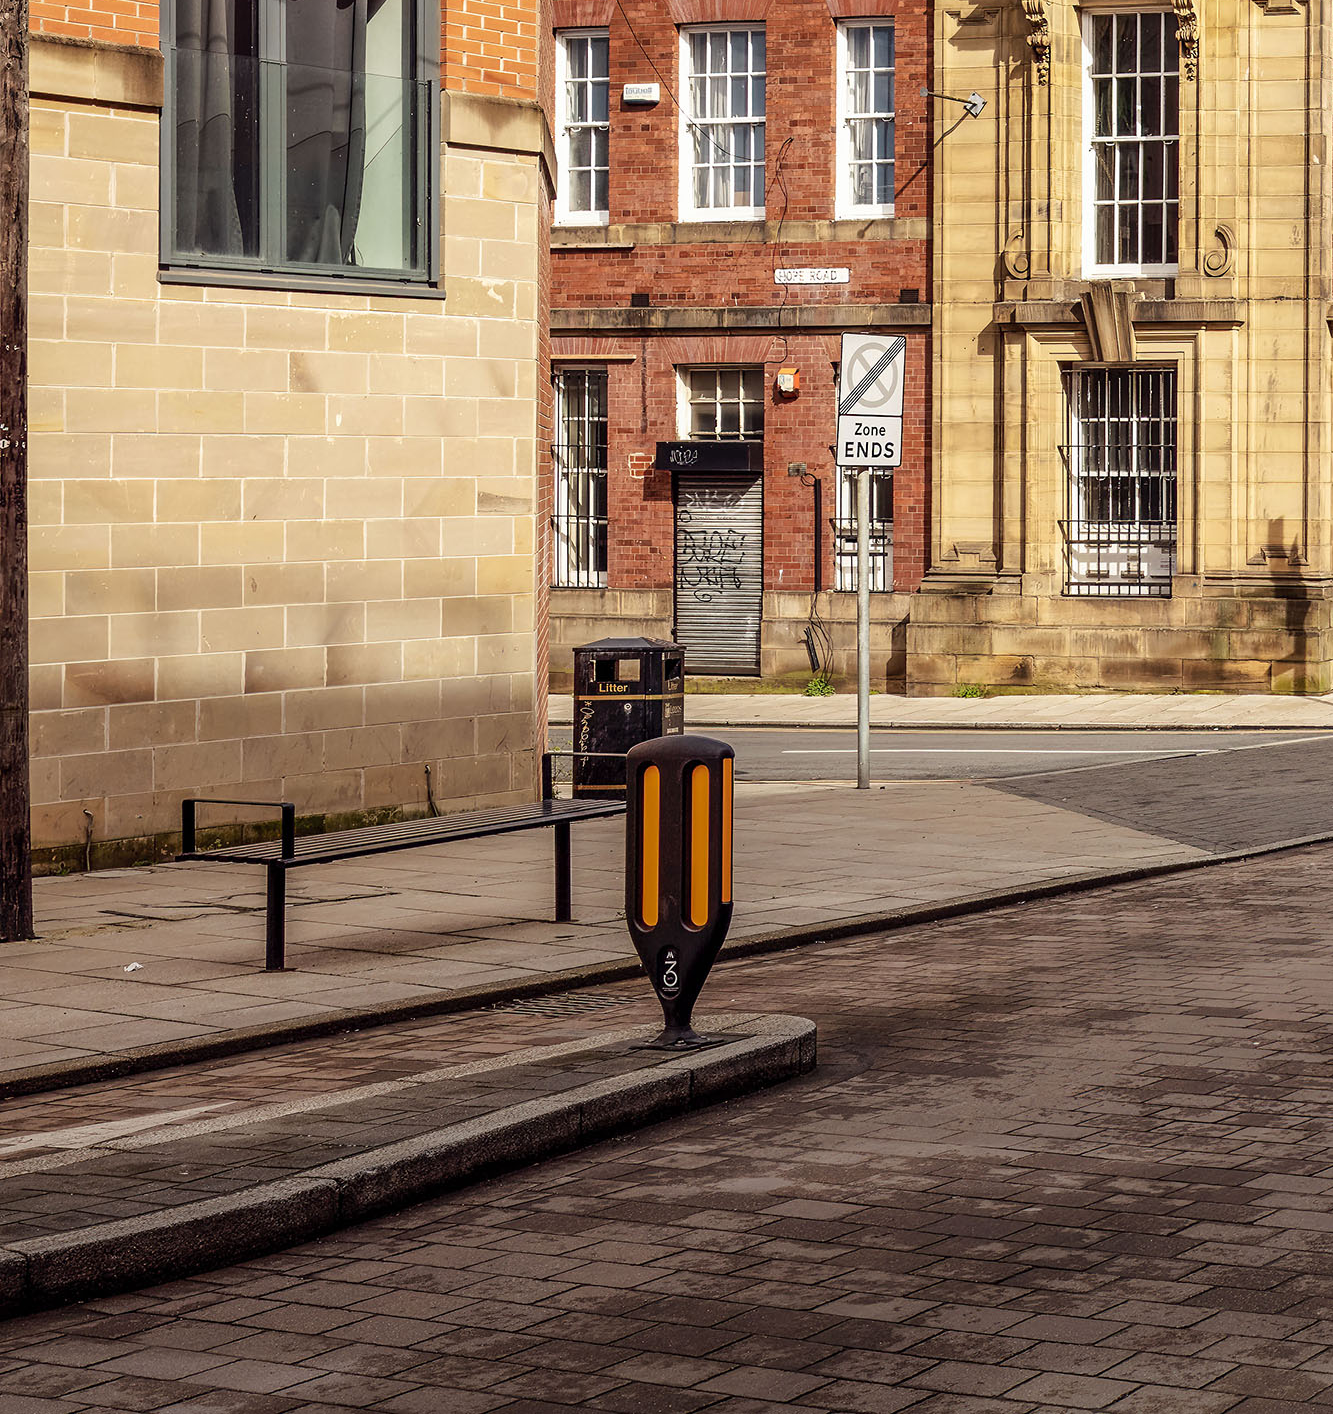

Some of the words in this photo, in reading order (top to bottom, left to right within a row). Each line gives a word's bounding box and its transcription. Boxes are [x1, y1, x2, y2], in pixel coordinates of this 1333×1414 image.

[778, 270, 805, 282] HOPE
[809, 270, 837, 281] ROAD
[854, 422, 886, 436] Zone
[844, 441, 895, 458] ENDS
[598, 683, 628, 693] Litter
